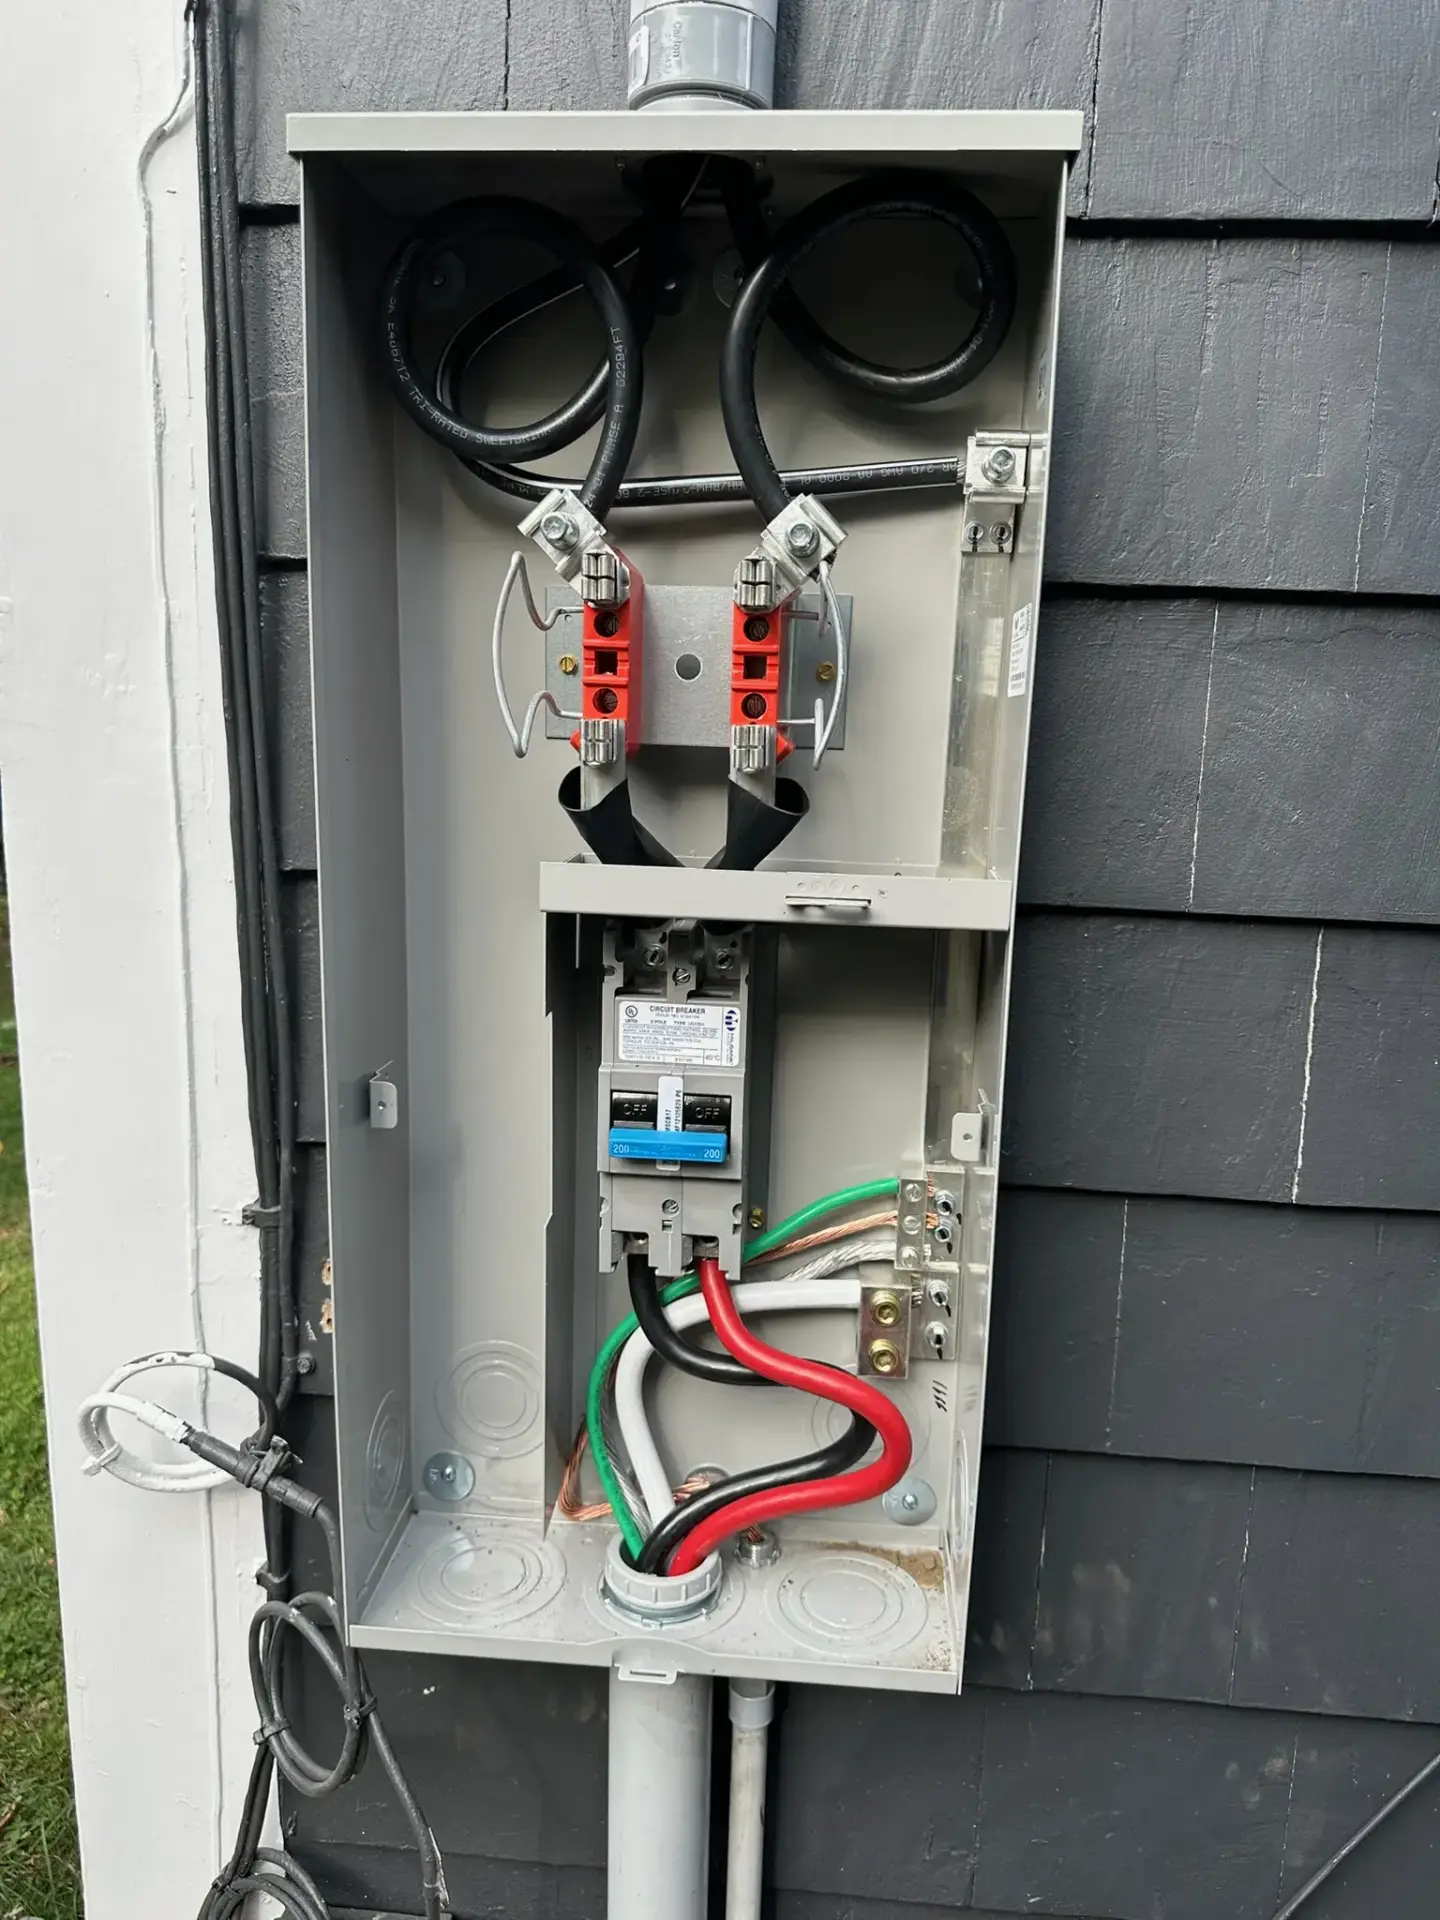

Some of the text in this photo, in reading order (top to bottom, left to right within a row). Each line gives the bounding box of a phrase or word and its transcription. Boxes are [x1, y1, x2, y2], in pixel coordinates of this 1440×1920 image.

[601, 416, 621, 465] PHASE
[880, 466, 904, 478] AWG
[911, 464, 935, 475] 2/0
[649, 1005, 706, 1015] CIRCUIT BREAKER
[623, 1103, 648, 1116] OFF
[694, 1106, 721, 1120] OFF
[613, 1143, 630, 1154] 200
[703, 1148, 721, 1159] 200
